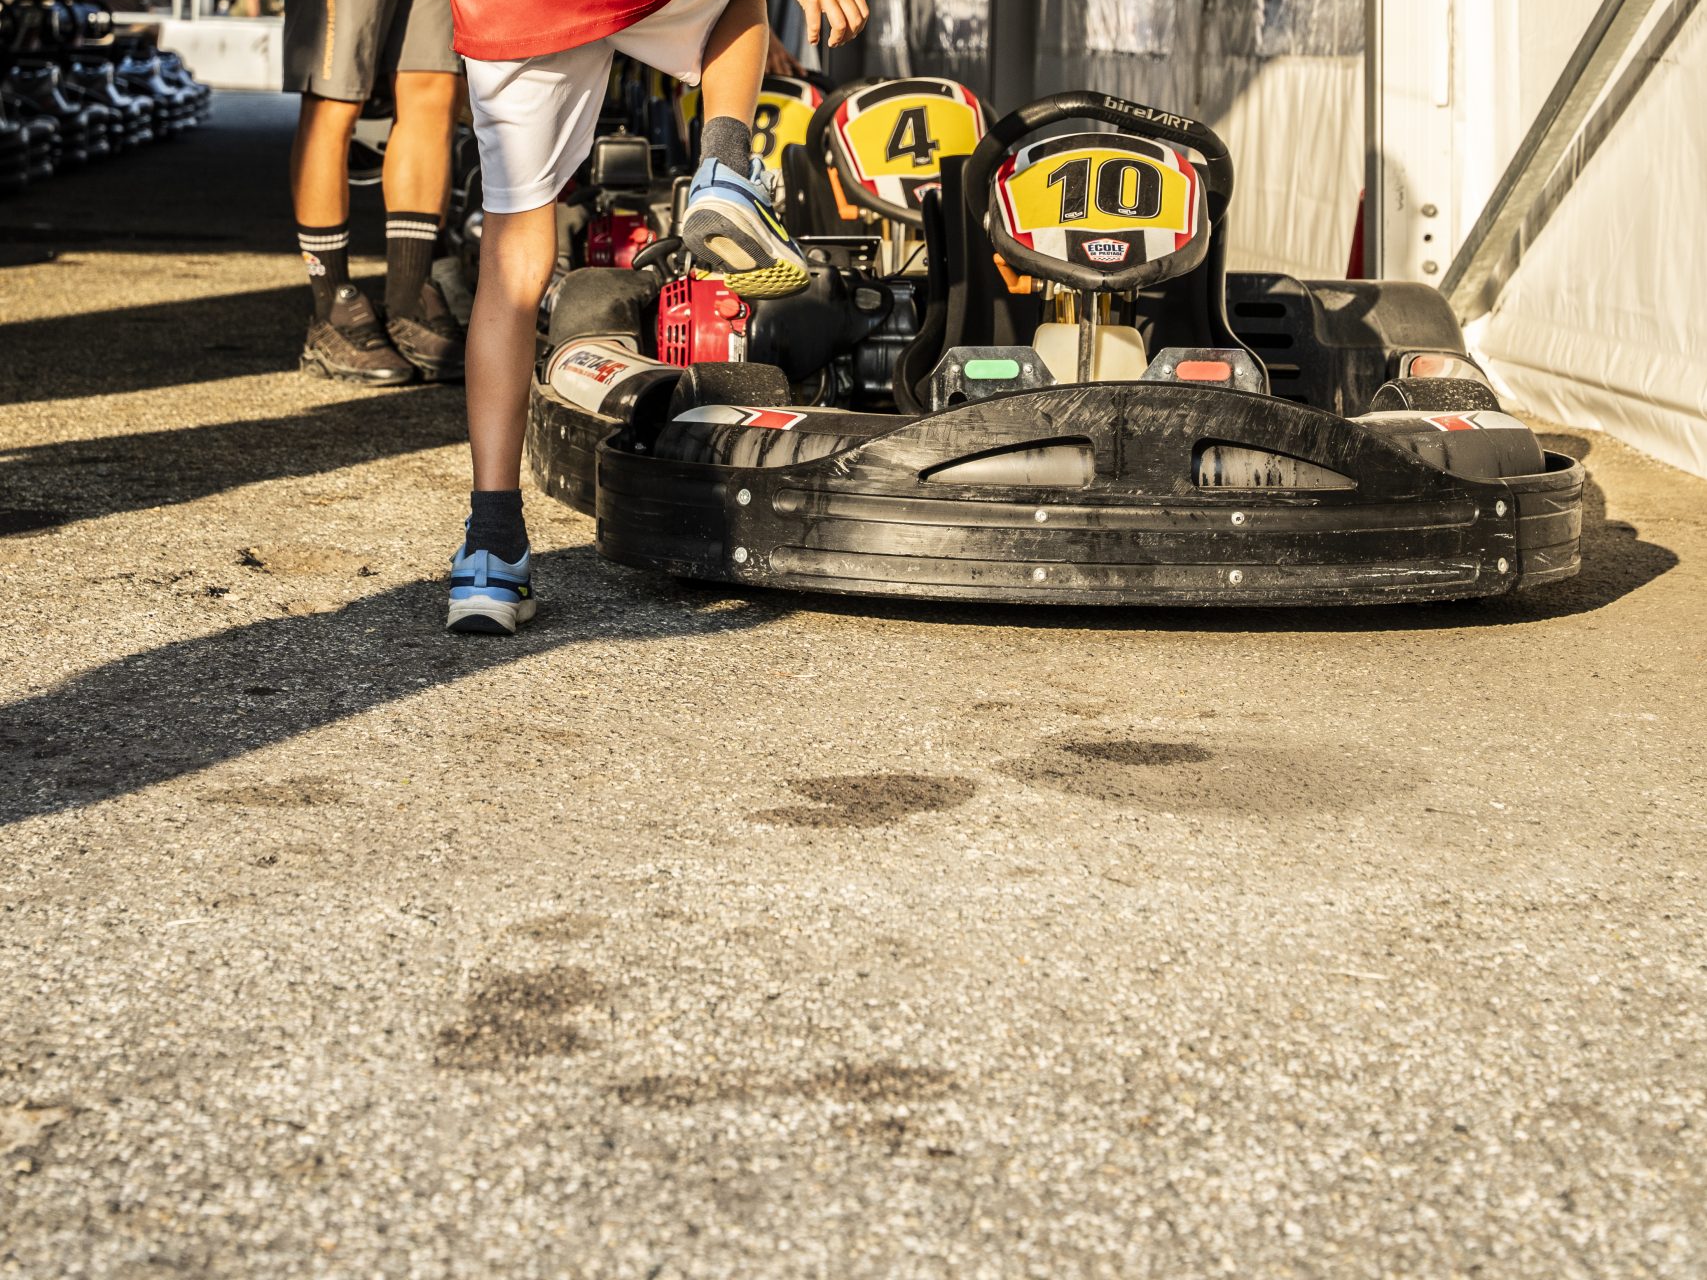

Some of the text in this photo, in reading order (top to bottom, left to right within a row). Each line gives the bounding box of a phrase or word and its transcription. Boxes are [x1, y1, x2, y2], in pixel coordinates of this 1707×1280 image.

[751, 103, 781, 158] 8
[885, 105, 941, 167] 4
[1103, 96, 1194, 131] birelART
[1047, 157, 1163, 224] 10
